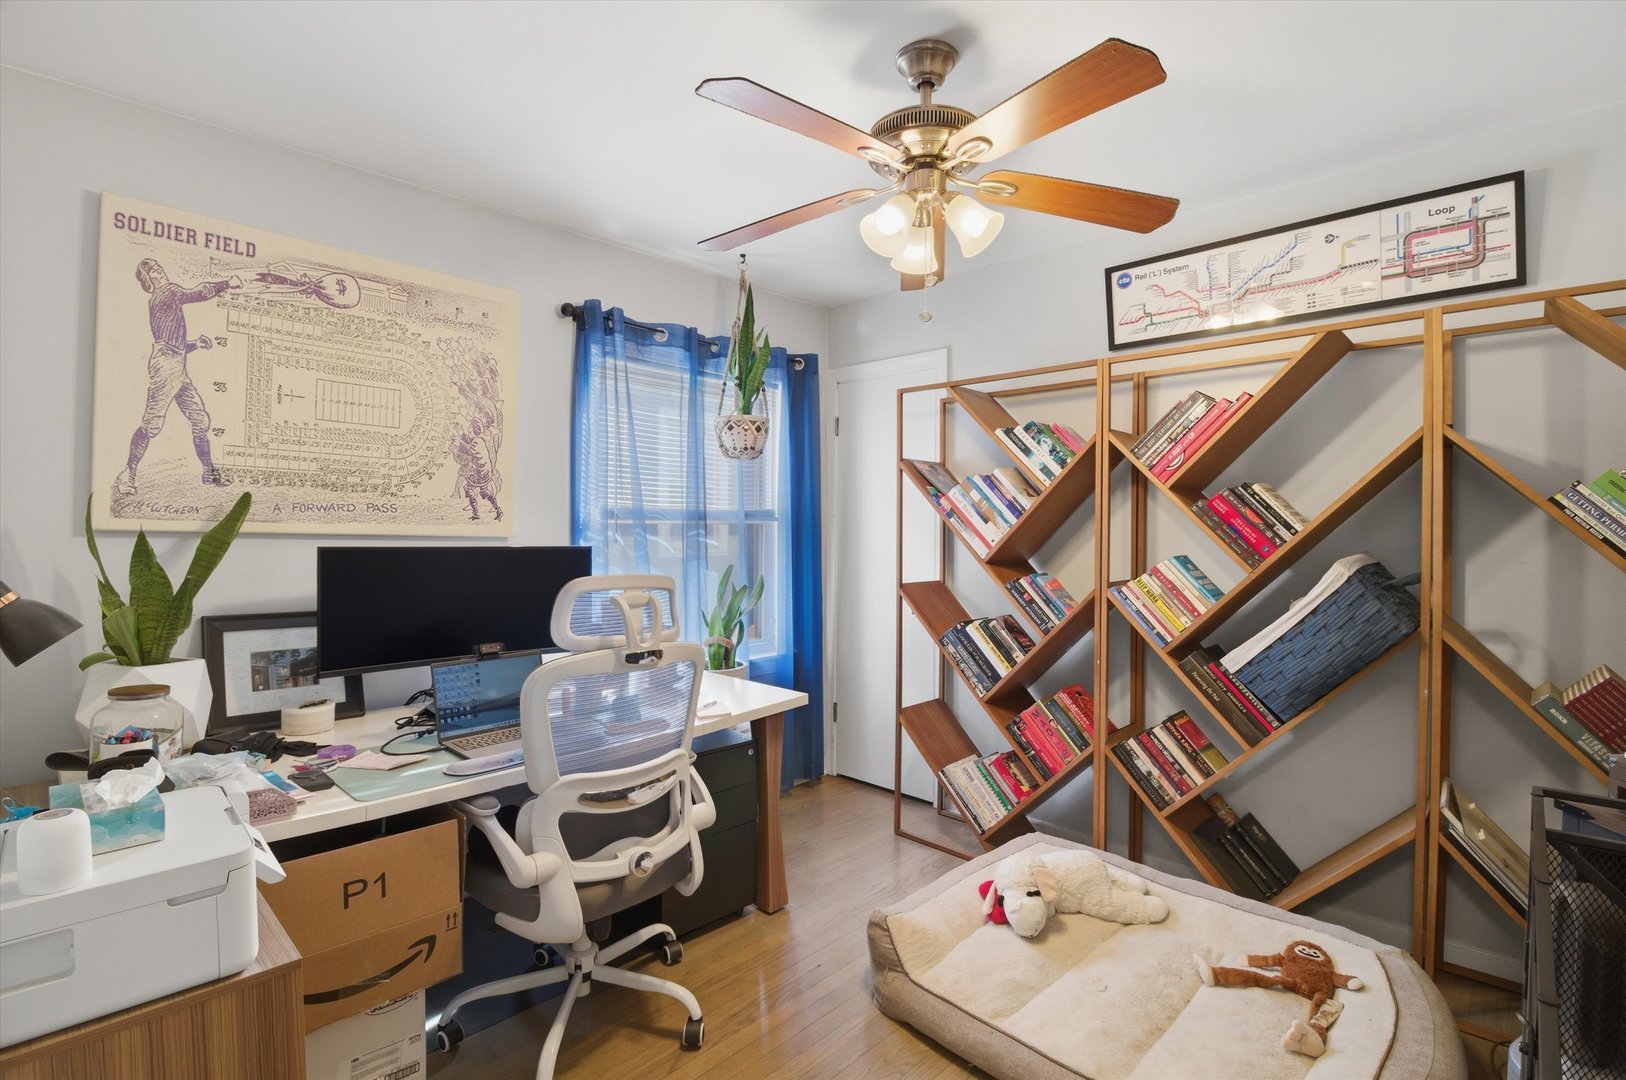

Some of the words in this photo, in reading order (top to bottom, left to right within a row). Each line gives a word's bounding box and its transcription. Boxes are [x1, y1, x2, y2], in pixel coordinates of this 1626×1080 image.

[1428, 205, 1456, 217] Loop
[113, 211, 198, 246] SOLDIER
[204, 231, 257, 259] FIELD
[1134, 271, 1148, 282] Rail
[1163, 264, 1190, 276] System
[1155, 418, 1175, 438] CENTURY
[1172, 410, 1182, 420] ART
[272, 503, 282, 514] A
[291, 502, 357, 513] FORWARD
[366, 502, 399, 514] PASS
[1566, 490, 1602, 519] GETTING
[1136, 578, 1147, 590] DEEP
[1145, 588, 1159, 603] WORK
[1156, 572, 1171, 588] TESLA
[1032, 709, 1054, 737] MAO
[1165, 721, 1181, 740] STEPHEN
[1179, 738, 1193, 753] KING
[343, 871, 387, 910] P1
